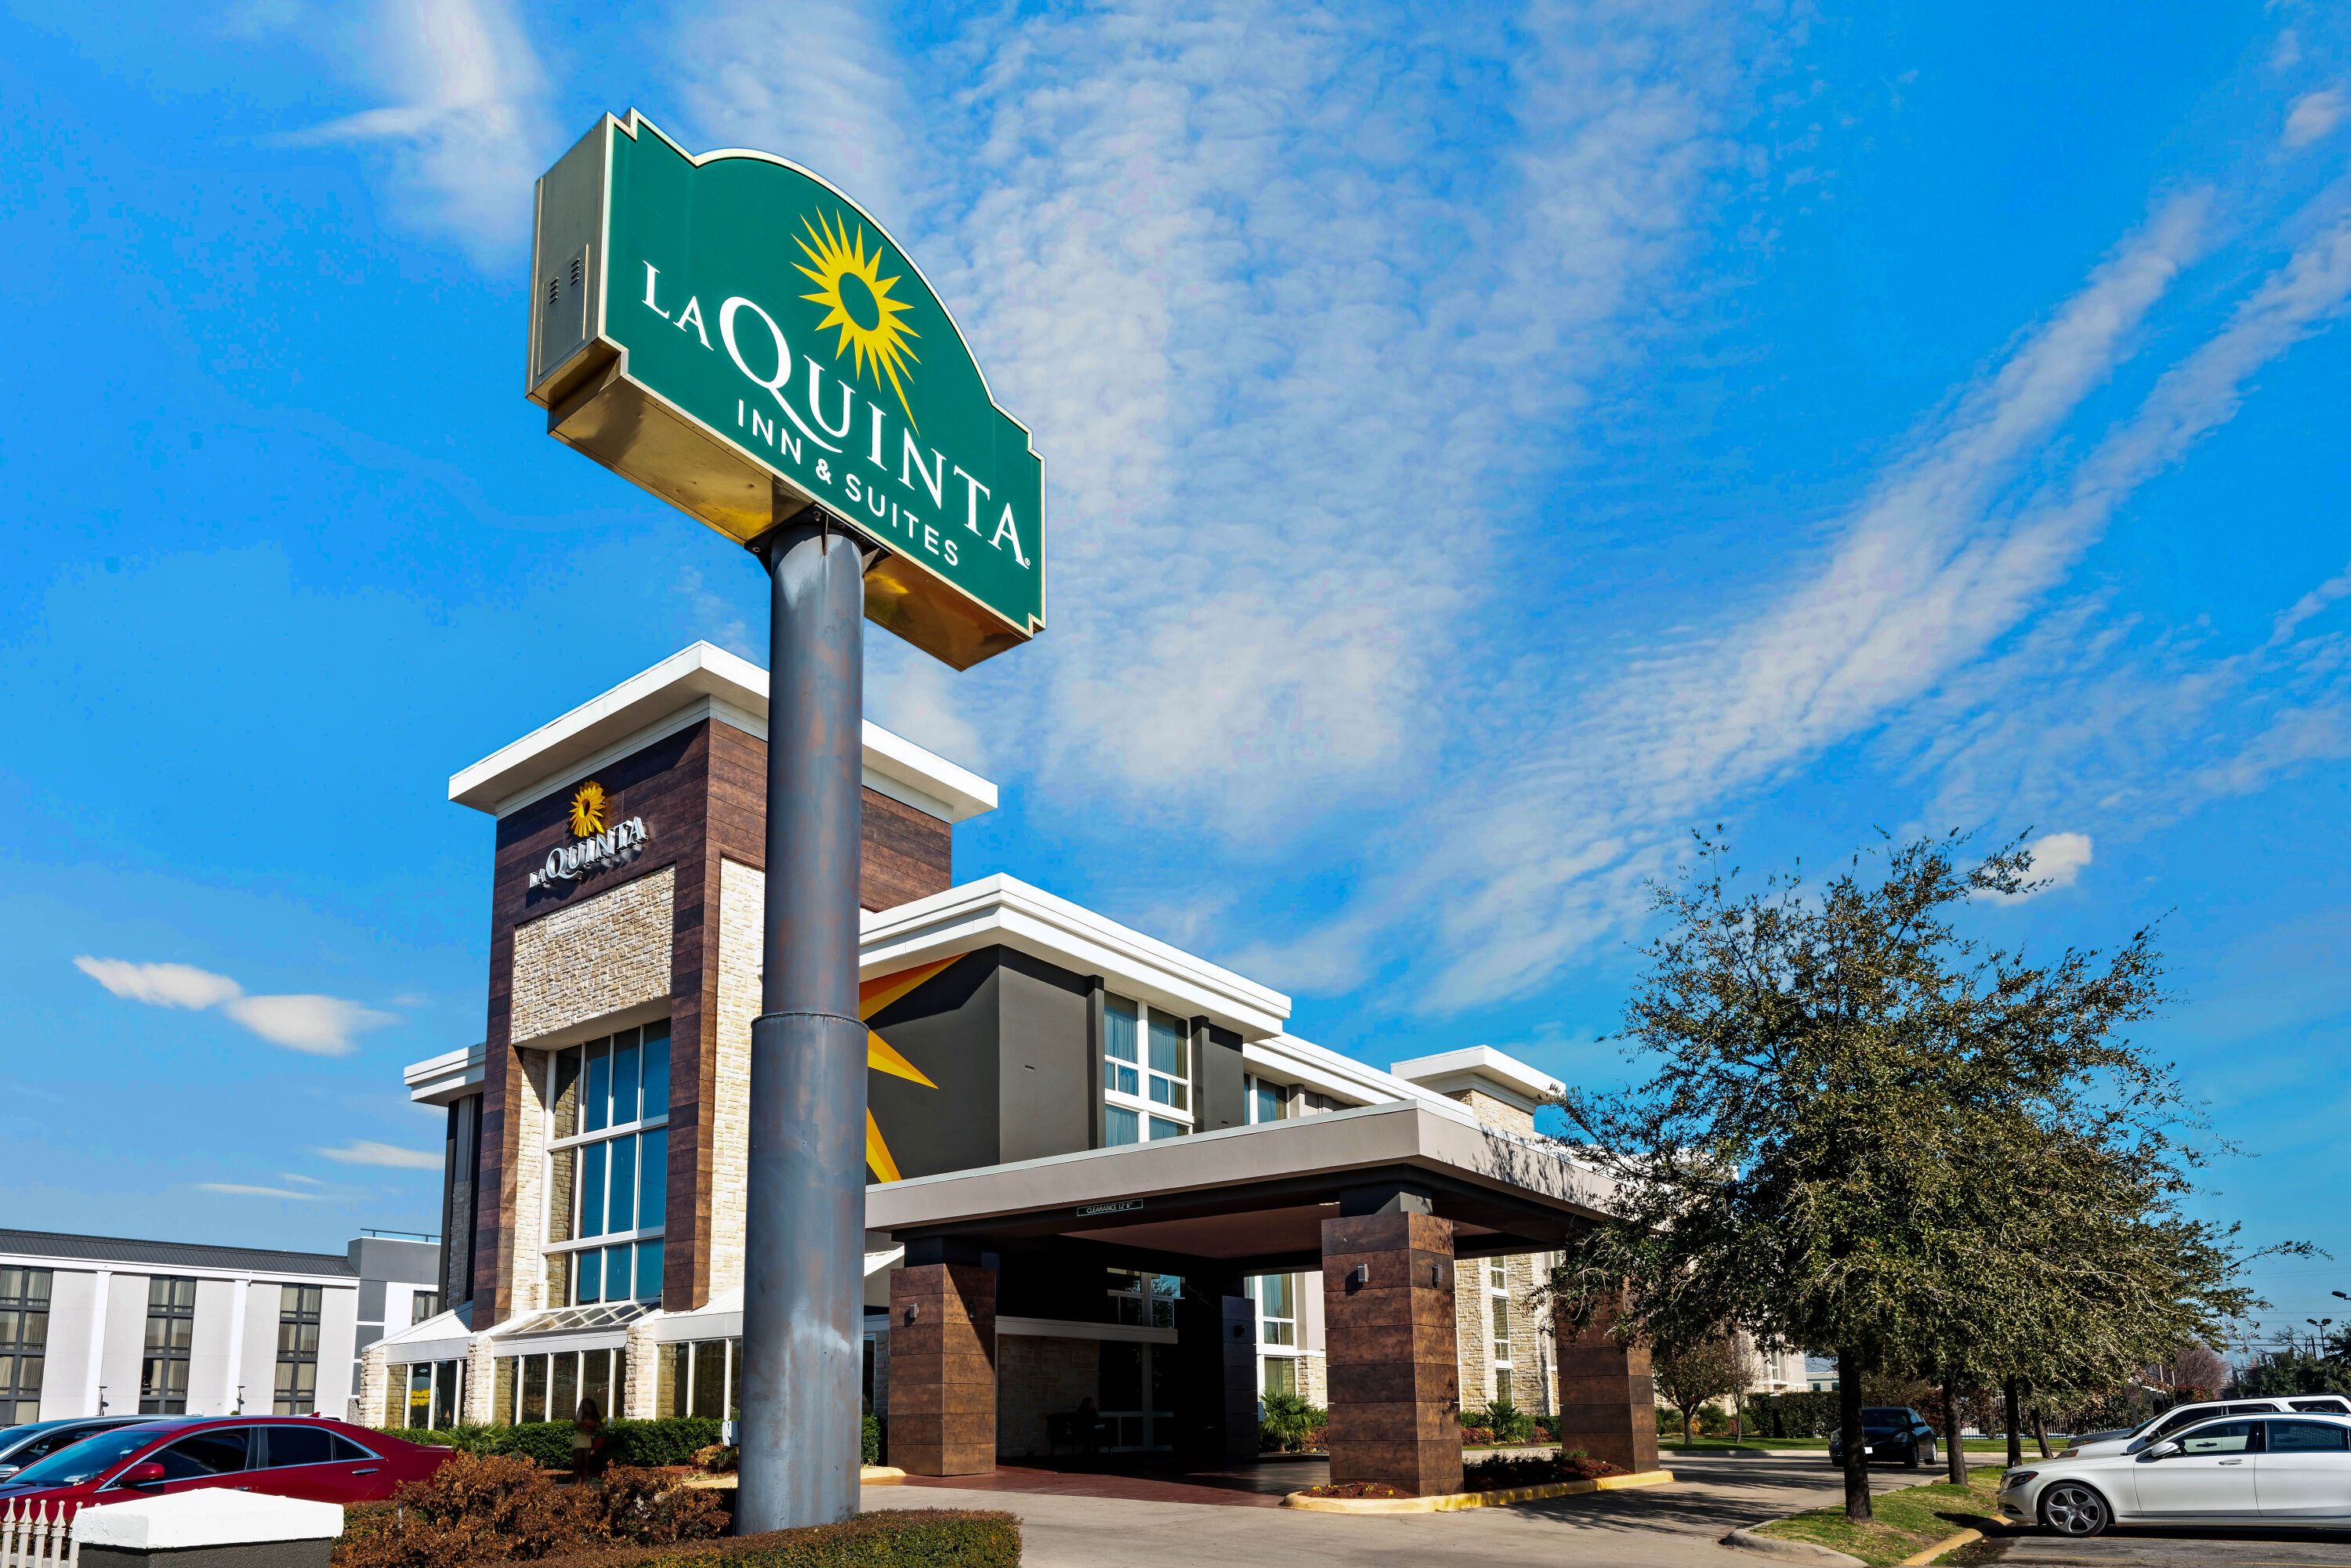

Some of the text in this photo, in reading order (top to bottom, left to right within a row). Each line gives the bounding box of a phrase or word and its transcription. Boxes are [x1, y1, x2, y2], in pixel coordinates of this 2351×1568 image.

[641, 259, 1031, 570] LA QUINTA
[737, 399, 958, 567] INN & SUITES
[529, 816, 649, 888] LA QUINTA
[1086, 1204, 1118, 1214] CLEARANCE
